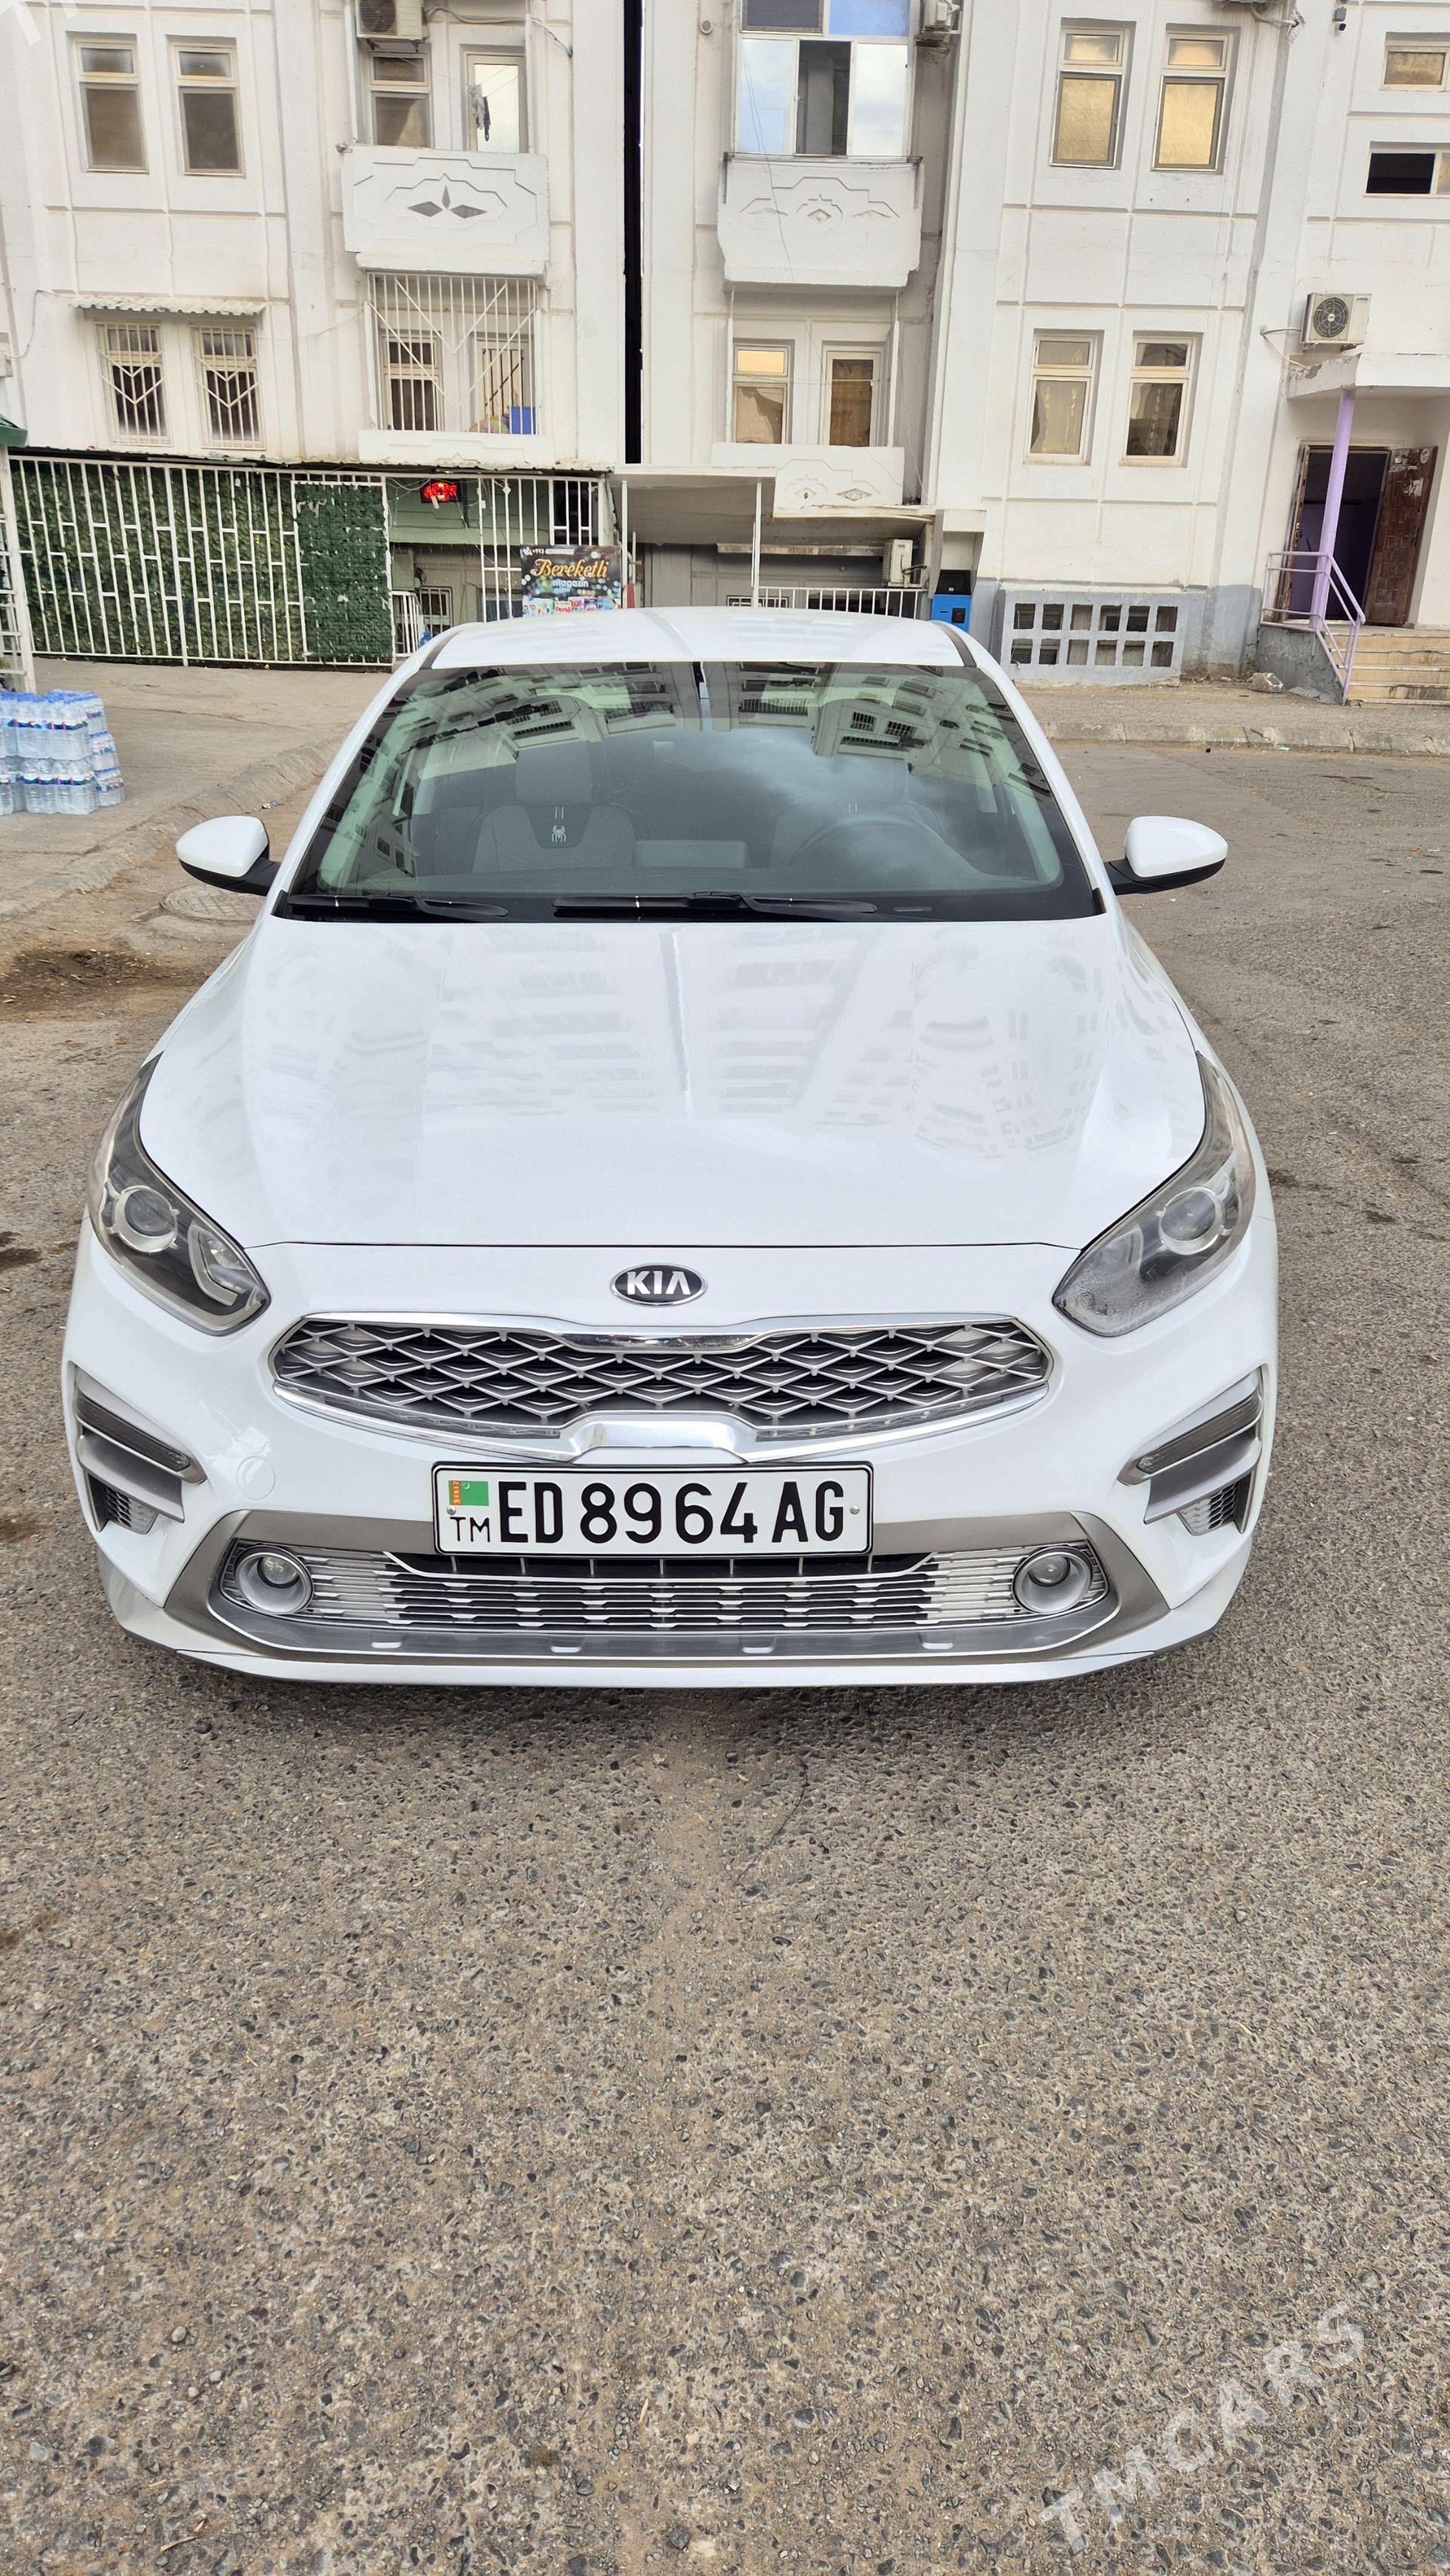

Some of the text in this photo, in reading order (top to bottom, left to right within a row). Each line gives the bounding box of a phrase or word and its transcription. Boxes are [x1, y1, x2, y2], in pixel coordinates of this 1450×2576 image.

[530, 558, 609, 578] Bereketli
[626, 1270, 691, 1296] KIA
[449, 1516, 491, 1543] TM
